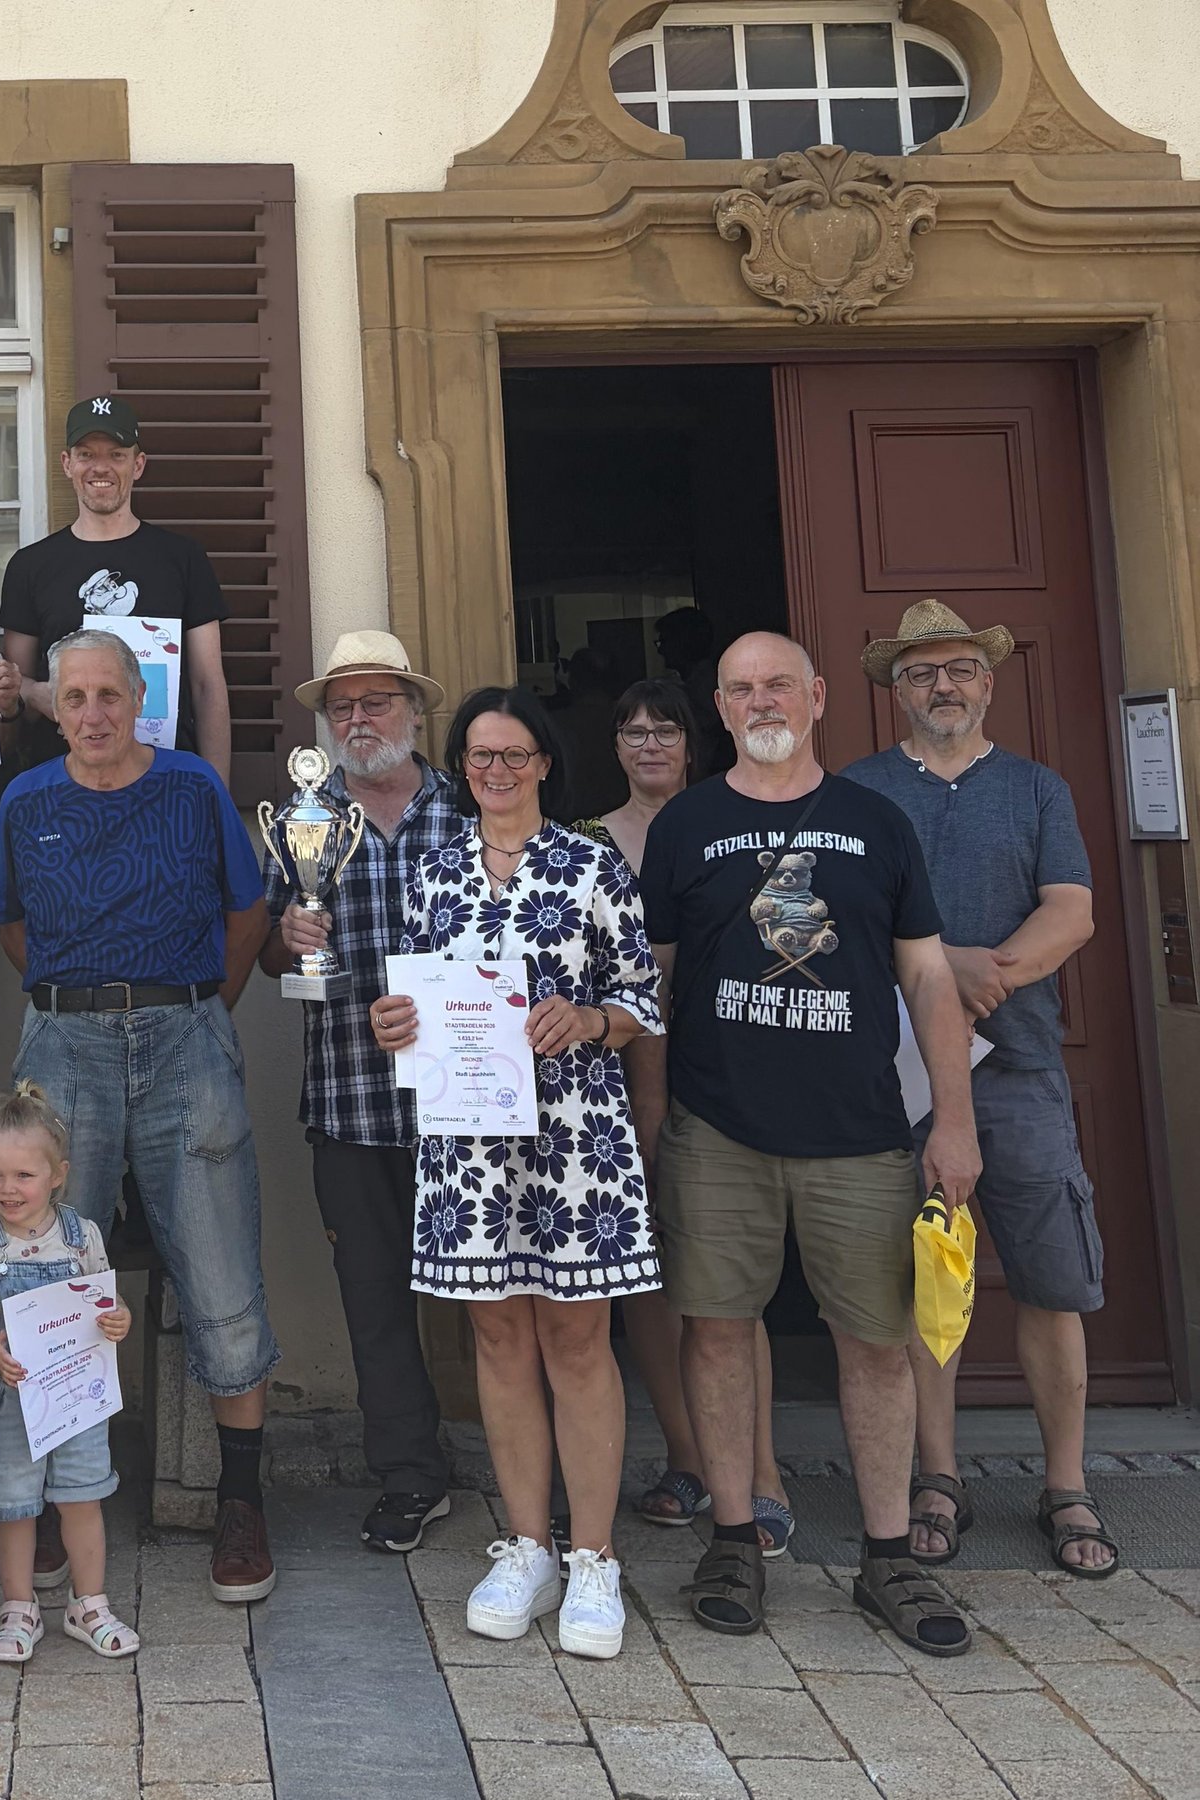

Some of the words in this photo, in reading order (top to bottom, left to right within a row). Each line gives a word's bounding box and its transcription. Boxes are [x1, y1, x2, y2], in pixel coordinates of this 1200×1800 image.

[92, 398, 111, 415] NY
[1136, 727, 1164, 738] Lauchheim
[703, 832, 765, 862] OFFIZIELL
[768, 831, 785, 847] IM
[716, 977, 749, 1002] AUCH
[752, 984, 785, 1007] EINE
[790, 988, 851, 1011] LEGENDE
[445, 1001, 492, 1011] Urkunde
[715, 997, 744, 1022] GEHT
[748, 1005, 781, 1027] MAL
[786, 1009, 803, 1029] IN
[807, 1010, 853, 1032] RENTE
[39, 1312, 82, 1334] Urkunde
[47, 1343, 66, 1355] Romy
[39, 1359, 78, 1385] STADTRADELN
